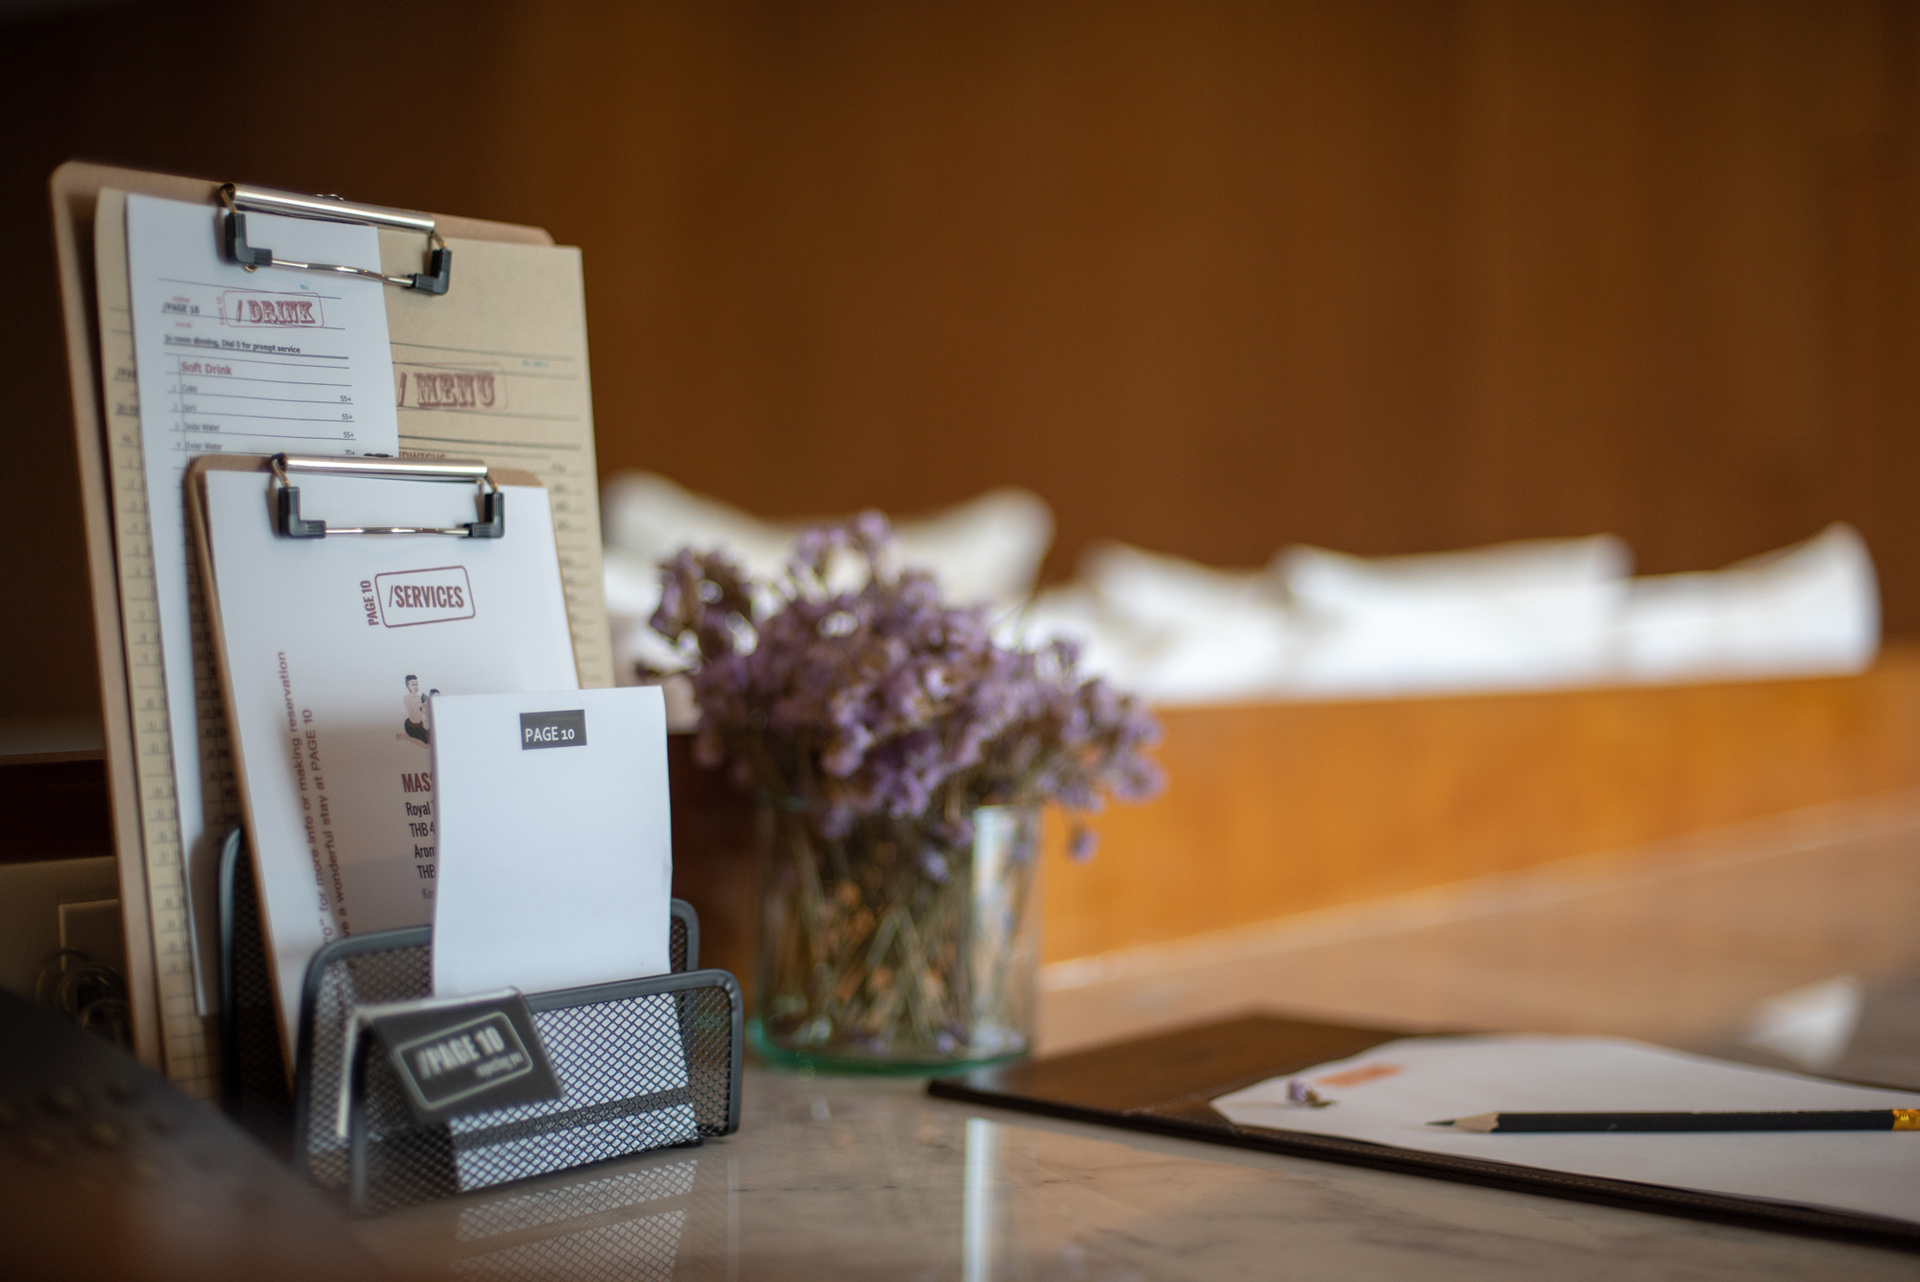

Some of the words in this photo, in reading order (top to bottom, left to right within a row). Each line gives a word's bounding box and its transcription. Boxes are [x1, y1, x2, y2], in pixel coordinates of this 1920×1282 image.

[246, 299, 316, 324] DRINK
[222, 340, 235, 348] Dial
[242, 341, 251, 349] for
[253, 343, 276, 353] prompt
[277, 345, 301, 353] service
[181, 361, 202, 374] Soft
[205, 363, 233, 376] Drink
[413, 371, 496, 409] MENU
[202, 423, 220, 431] Water
[360, 580, 373, 594] 10
[388, 585, 465, 608] /SERVICES
[364, 595, 380, 626] PAGE
[278, 651, 298, 733] reservation
[302, 708, 313, 724] 10
[525, 726, 560, 743] PAGE
[561, 728, 575, 741] 10
[305, 729, 322, 771] PAGE
[292, 737, 308, 791] making
[314, 775, 326, 790] at
[401, 772, 433, 793] MAS
[302, 796, 311, 811] or
[318, 795, 331, 826] stay
[405, 801, 431, 817] Royal
[304, 815, 317, 843] info
[409, 822, 429, 838] THB
[312, 849, 325, 886] more
[323, 830, 345, 902] wonderful
[416, 864, 436, 880] THB
[319, 891, 329, 912] for
[475, 1026, 505, 1056] 10
